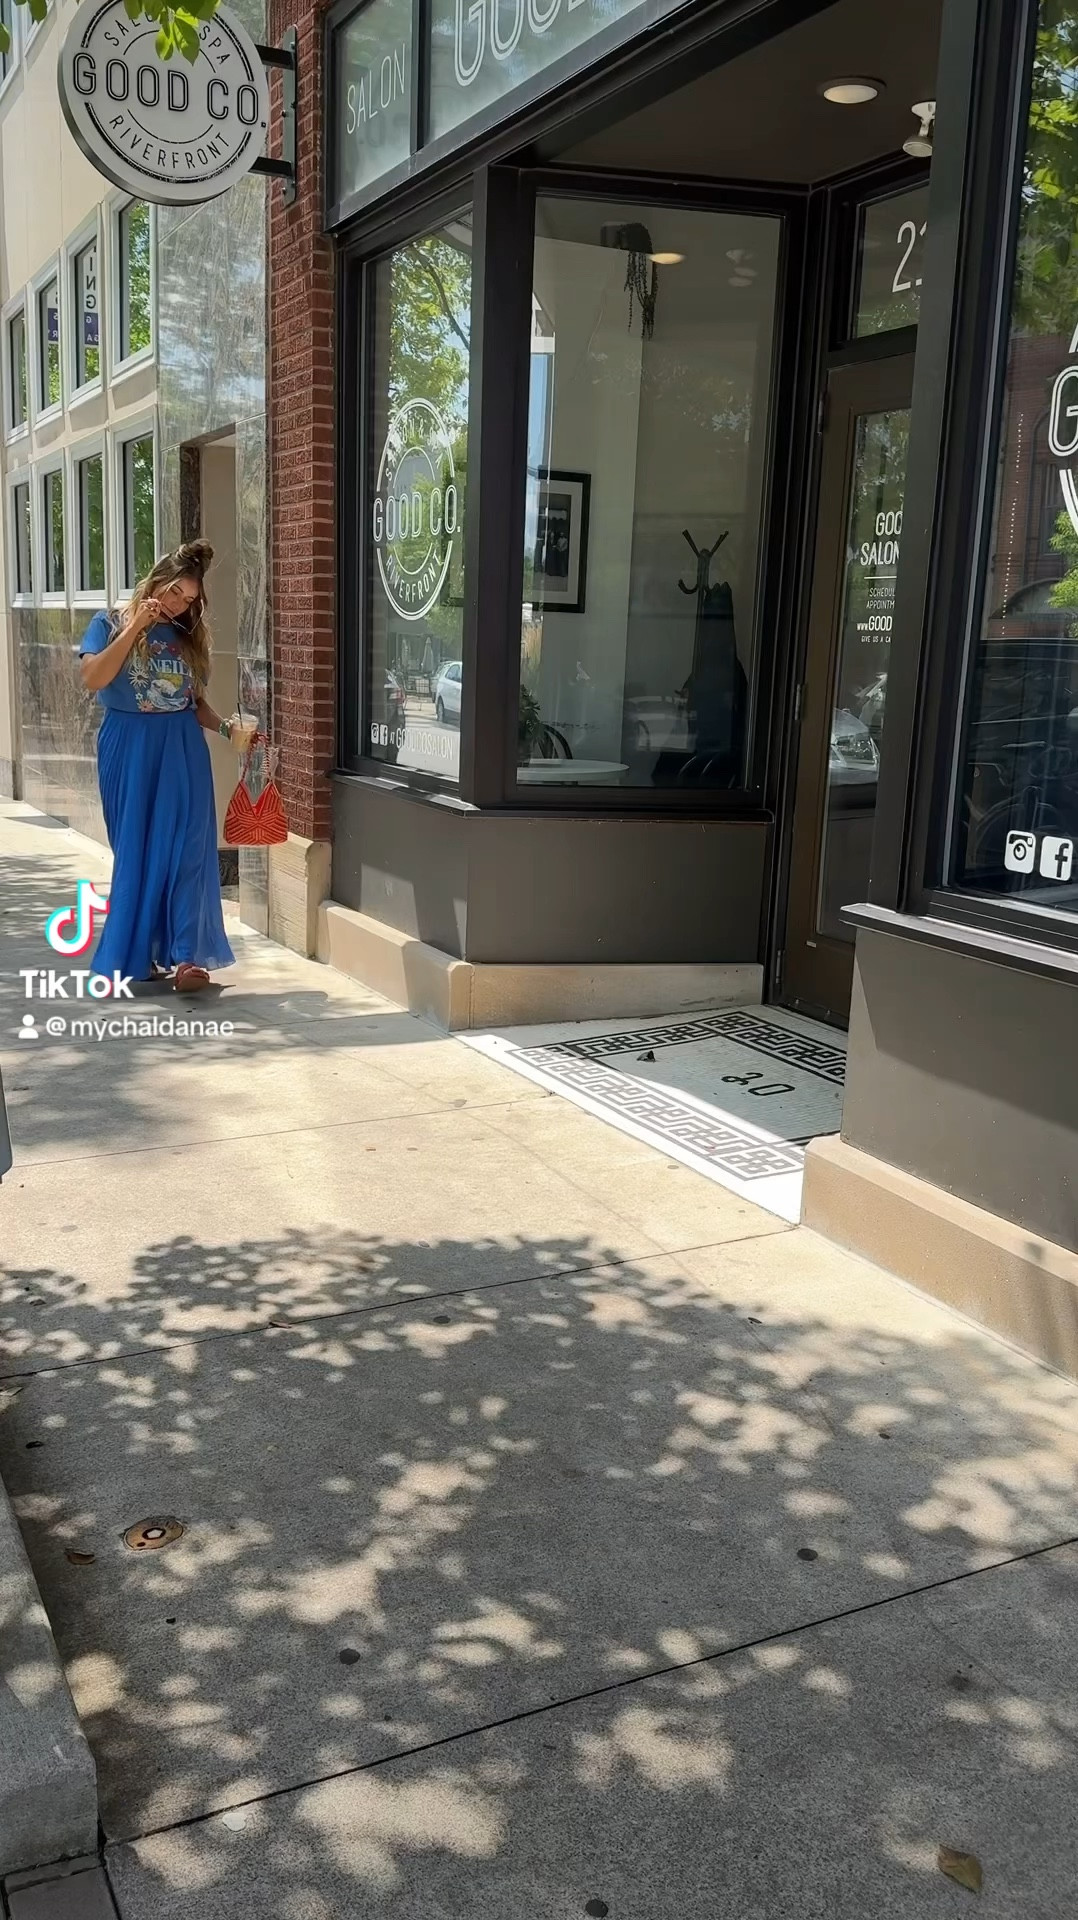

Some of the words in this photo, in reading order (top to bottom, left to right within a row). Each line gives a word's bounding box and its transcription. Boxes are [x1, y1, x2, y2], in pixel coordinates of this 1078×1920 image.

[199, 25, 230, 65] SPA
[73, 52, 189, 112] GOOD
[207, 78, 266, 128] CO.
[346, 43, 406, 135] SALON
[109, 114, 230, 169] RIVERFRONT
[373, 491, 422, 542] GOOD
[430, 484, 461, 536] CO.
[385, 549, 444, 603] RIVERFRONT
[860, 540, 900, 566] SALON
